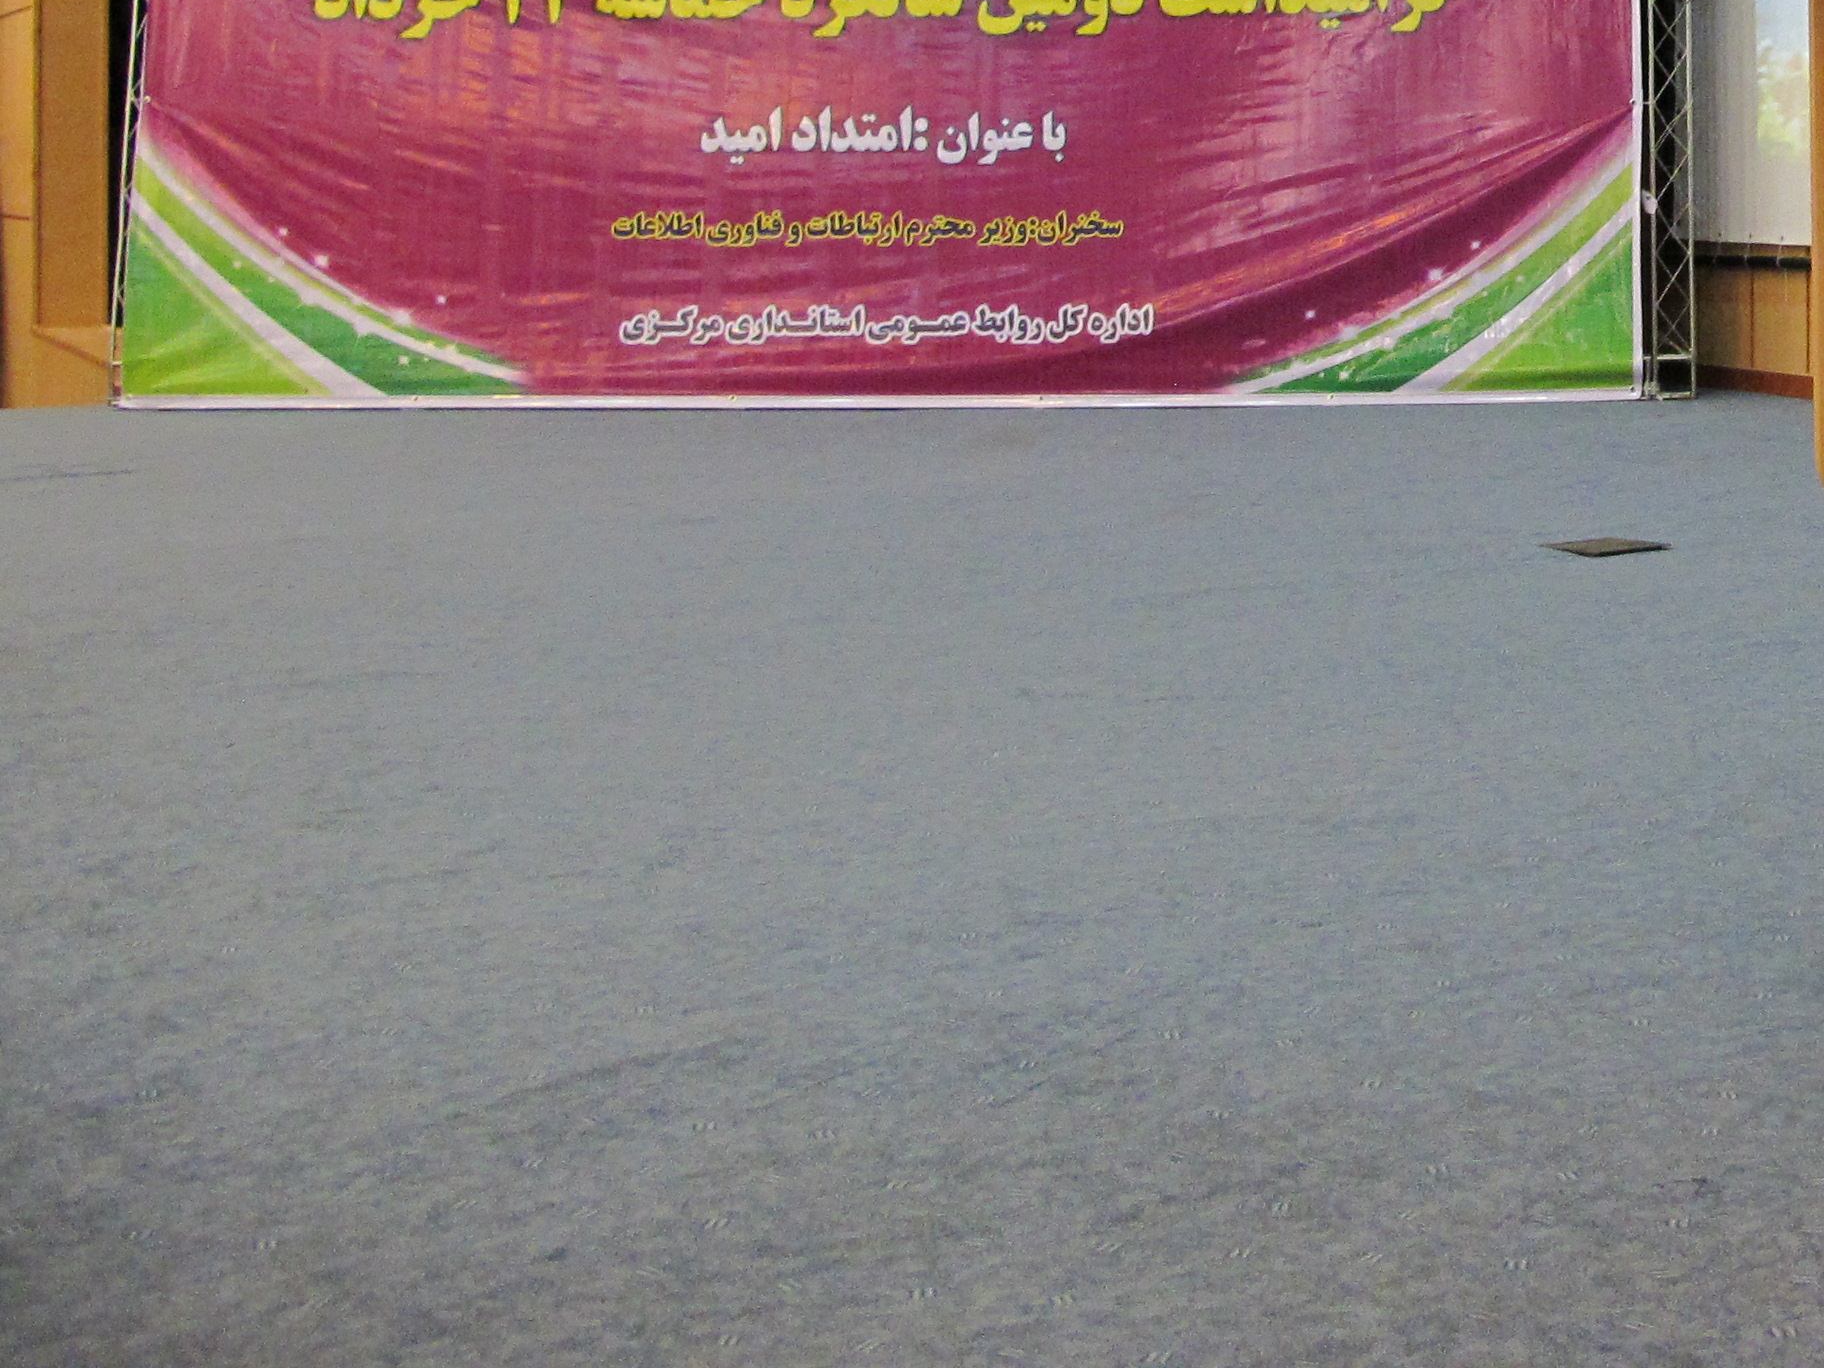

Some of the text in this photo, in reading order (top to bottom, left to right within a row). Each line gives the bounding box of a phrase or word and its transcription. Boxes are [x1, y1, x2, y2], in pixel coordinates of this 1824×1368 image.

[700, 105, 782, 165] امید
[1042, 111, 1067, 162] با
[611, 210, 704, 239] اطلاعات
[706, 210, 784, 246] فناوری
[785, 221, 803, 246] و
[805, 210, 903, 246] ارتباطات
[904, 215, 976, 246] محترم
[619, 303, 1154, 345] اداره کل روابط عمومی استانداری مرکزی
